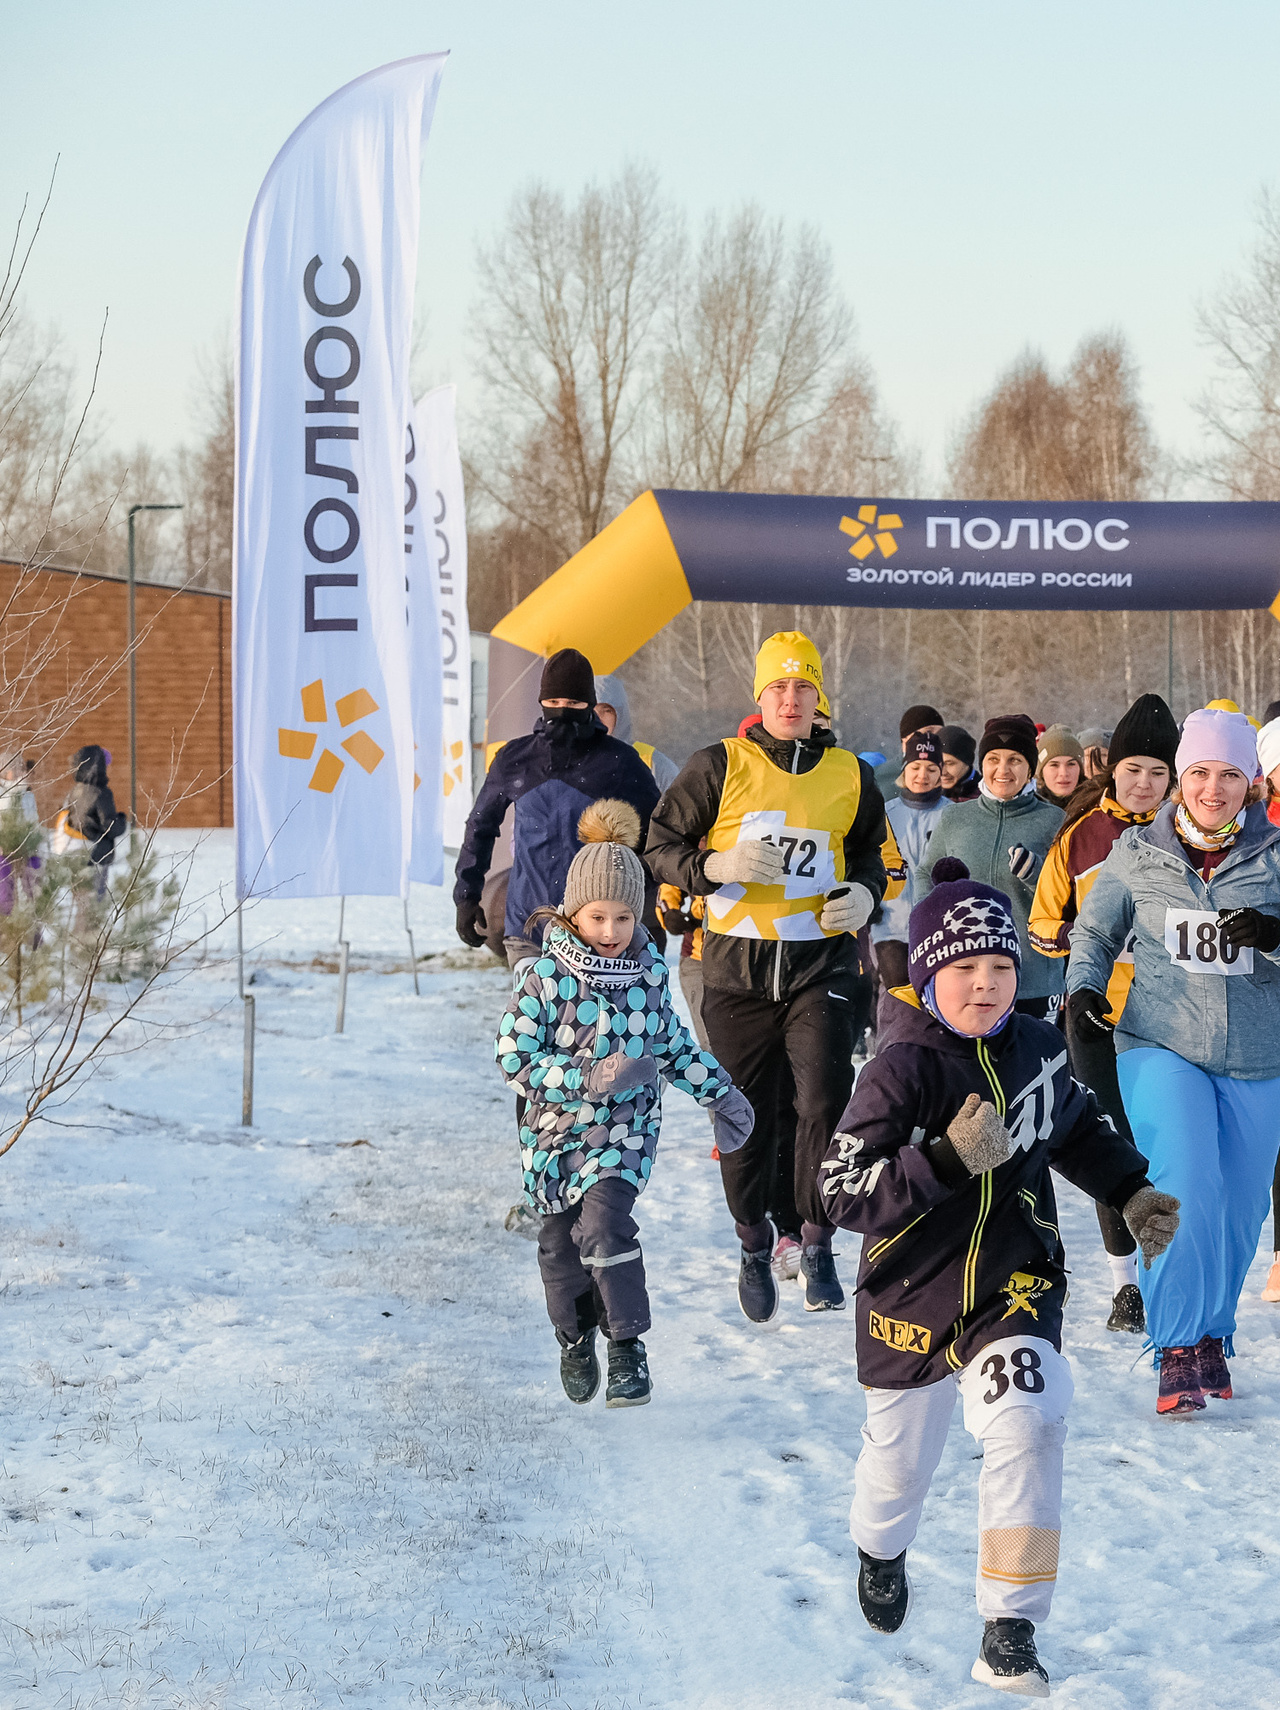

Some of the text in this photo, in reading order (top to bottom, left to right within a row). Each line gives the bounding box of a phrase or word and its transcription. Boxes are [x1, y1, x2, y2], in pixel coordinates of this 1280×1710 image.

[303, 254, 361, 633] ПОЛЮС
[926, 516, 1130, 551] ПОЛЮС
[846, 567, 1133, 588] ЗОЛОТОЙ ЛИДЕР РОССИИ
[910, 930, 945, 965] UEFA
[870, 1314, 929, 1352] REX
[980, 1347, 1046, 1405] 38
